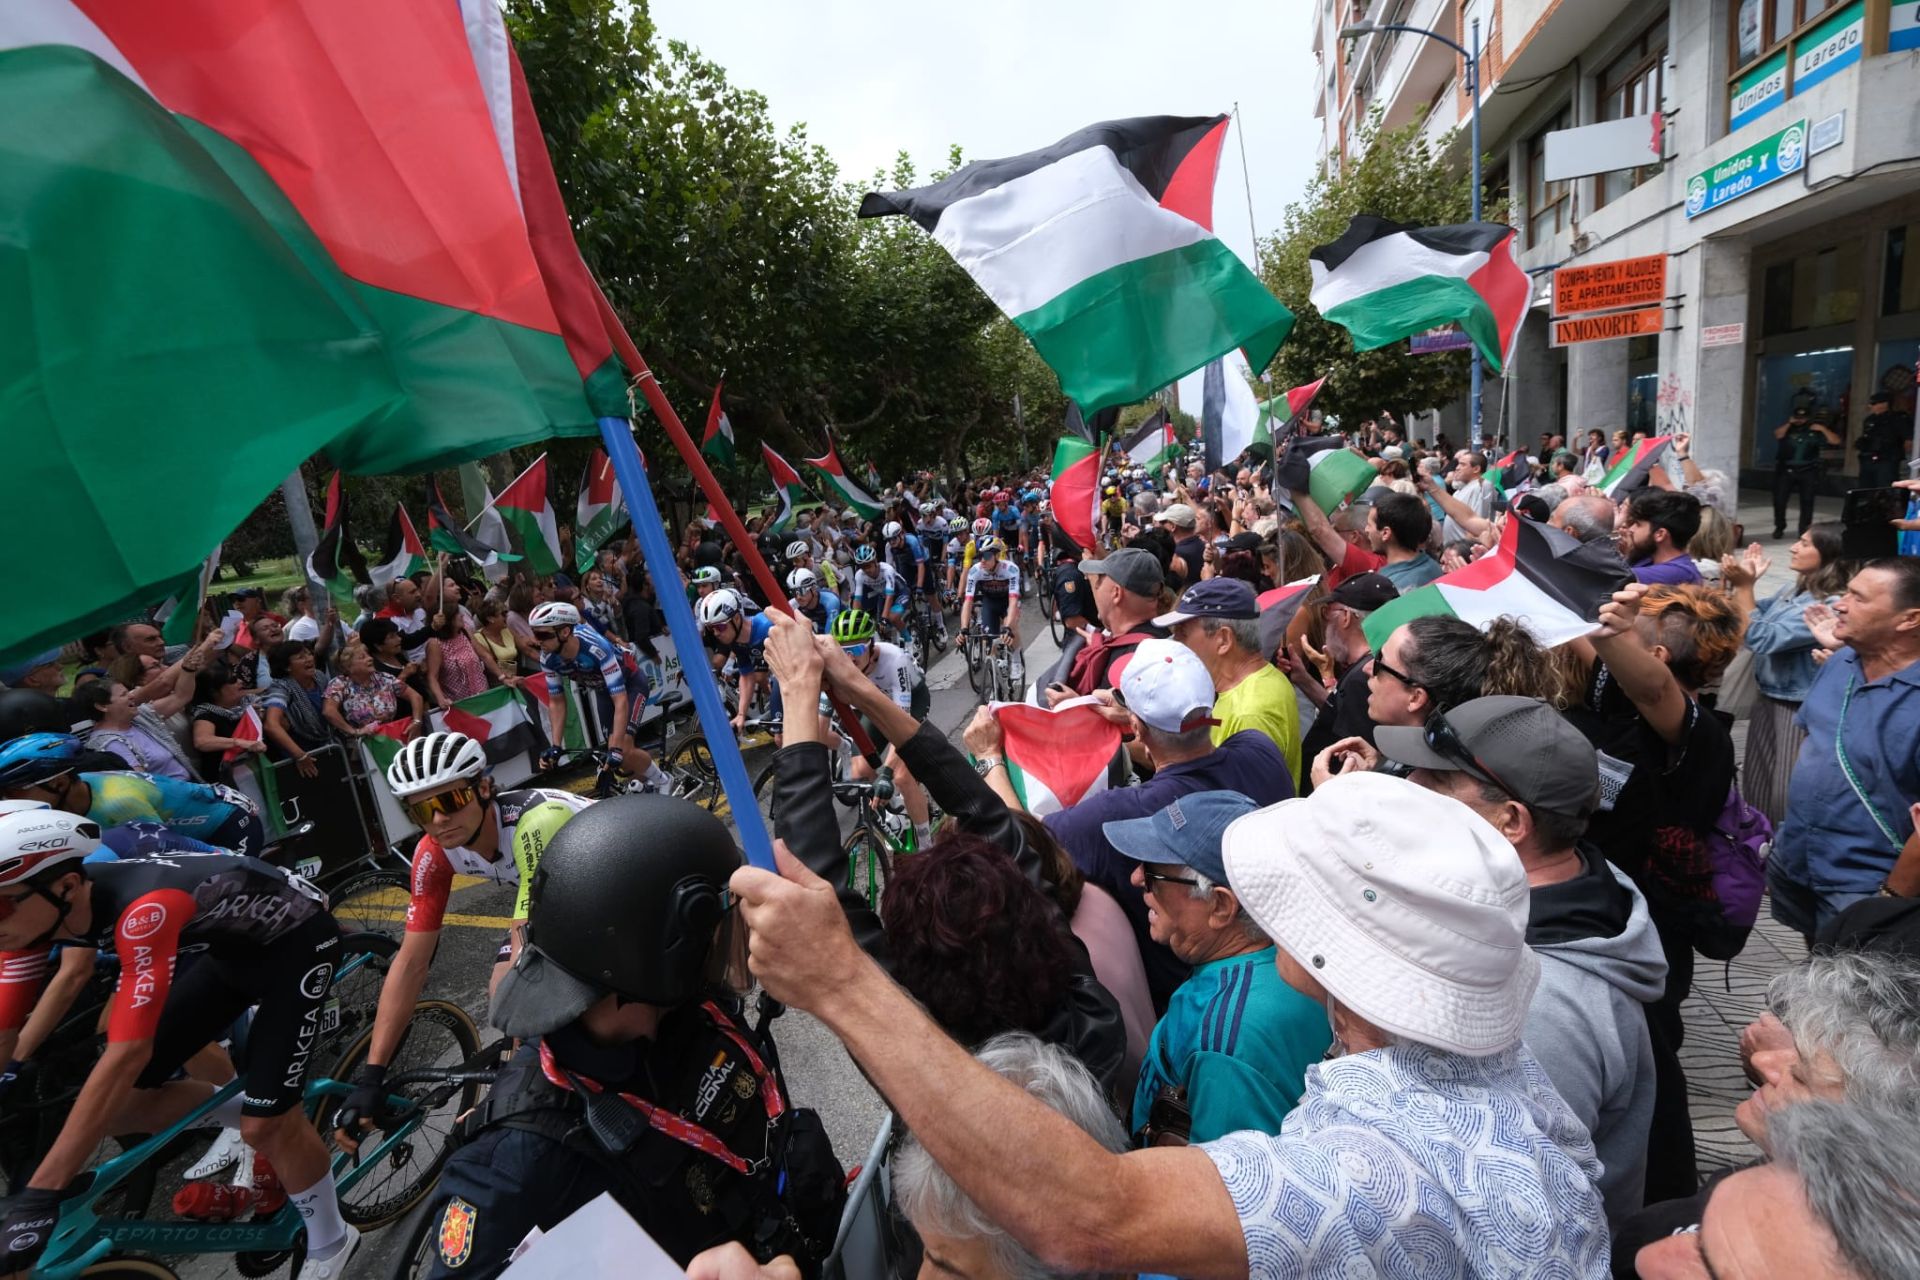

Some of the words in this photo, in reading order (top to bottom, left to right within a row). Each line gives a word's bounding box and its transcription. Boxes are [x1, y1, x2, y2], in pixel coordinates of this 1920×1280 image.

[1738, 76, 1782, 111] Unidos
[1803, 29, 1858, 72] Laredo
[1713, 154, 1754, 184] Unidos
[1712, 175, 1753, 203] Laredo
[1559, 289, 1574, 304] DE
[1579, 277, 1663, 300] APARTAMENTOS
[1557, 312, 1640, 344] INMONORTE
[126, 911, 161, 930] B&B
[197, 893, 292, 932] ARKEA
[130, 945, 154, 1009] ARKEA
[311, 966, 328, 995] B&B
[283, 1006, 320, 1088] ARKEA
[695, 1060, 736, 1122] CIONAL
[193, 1155, 233, 1178] nimbl
[7, 1218, 55, 1233] ARKEA
[205, 1226, 268, 1242] CORSE
